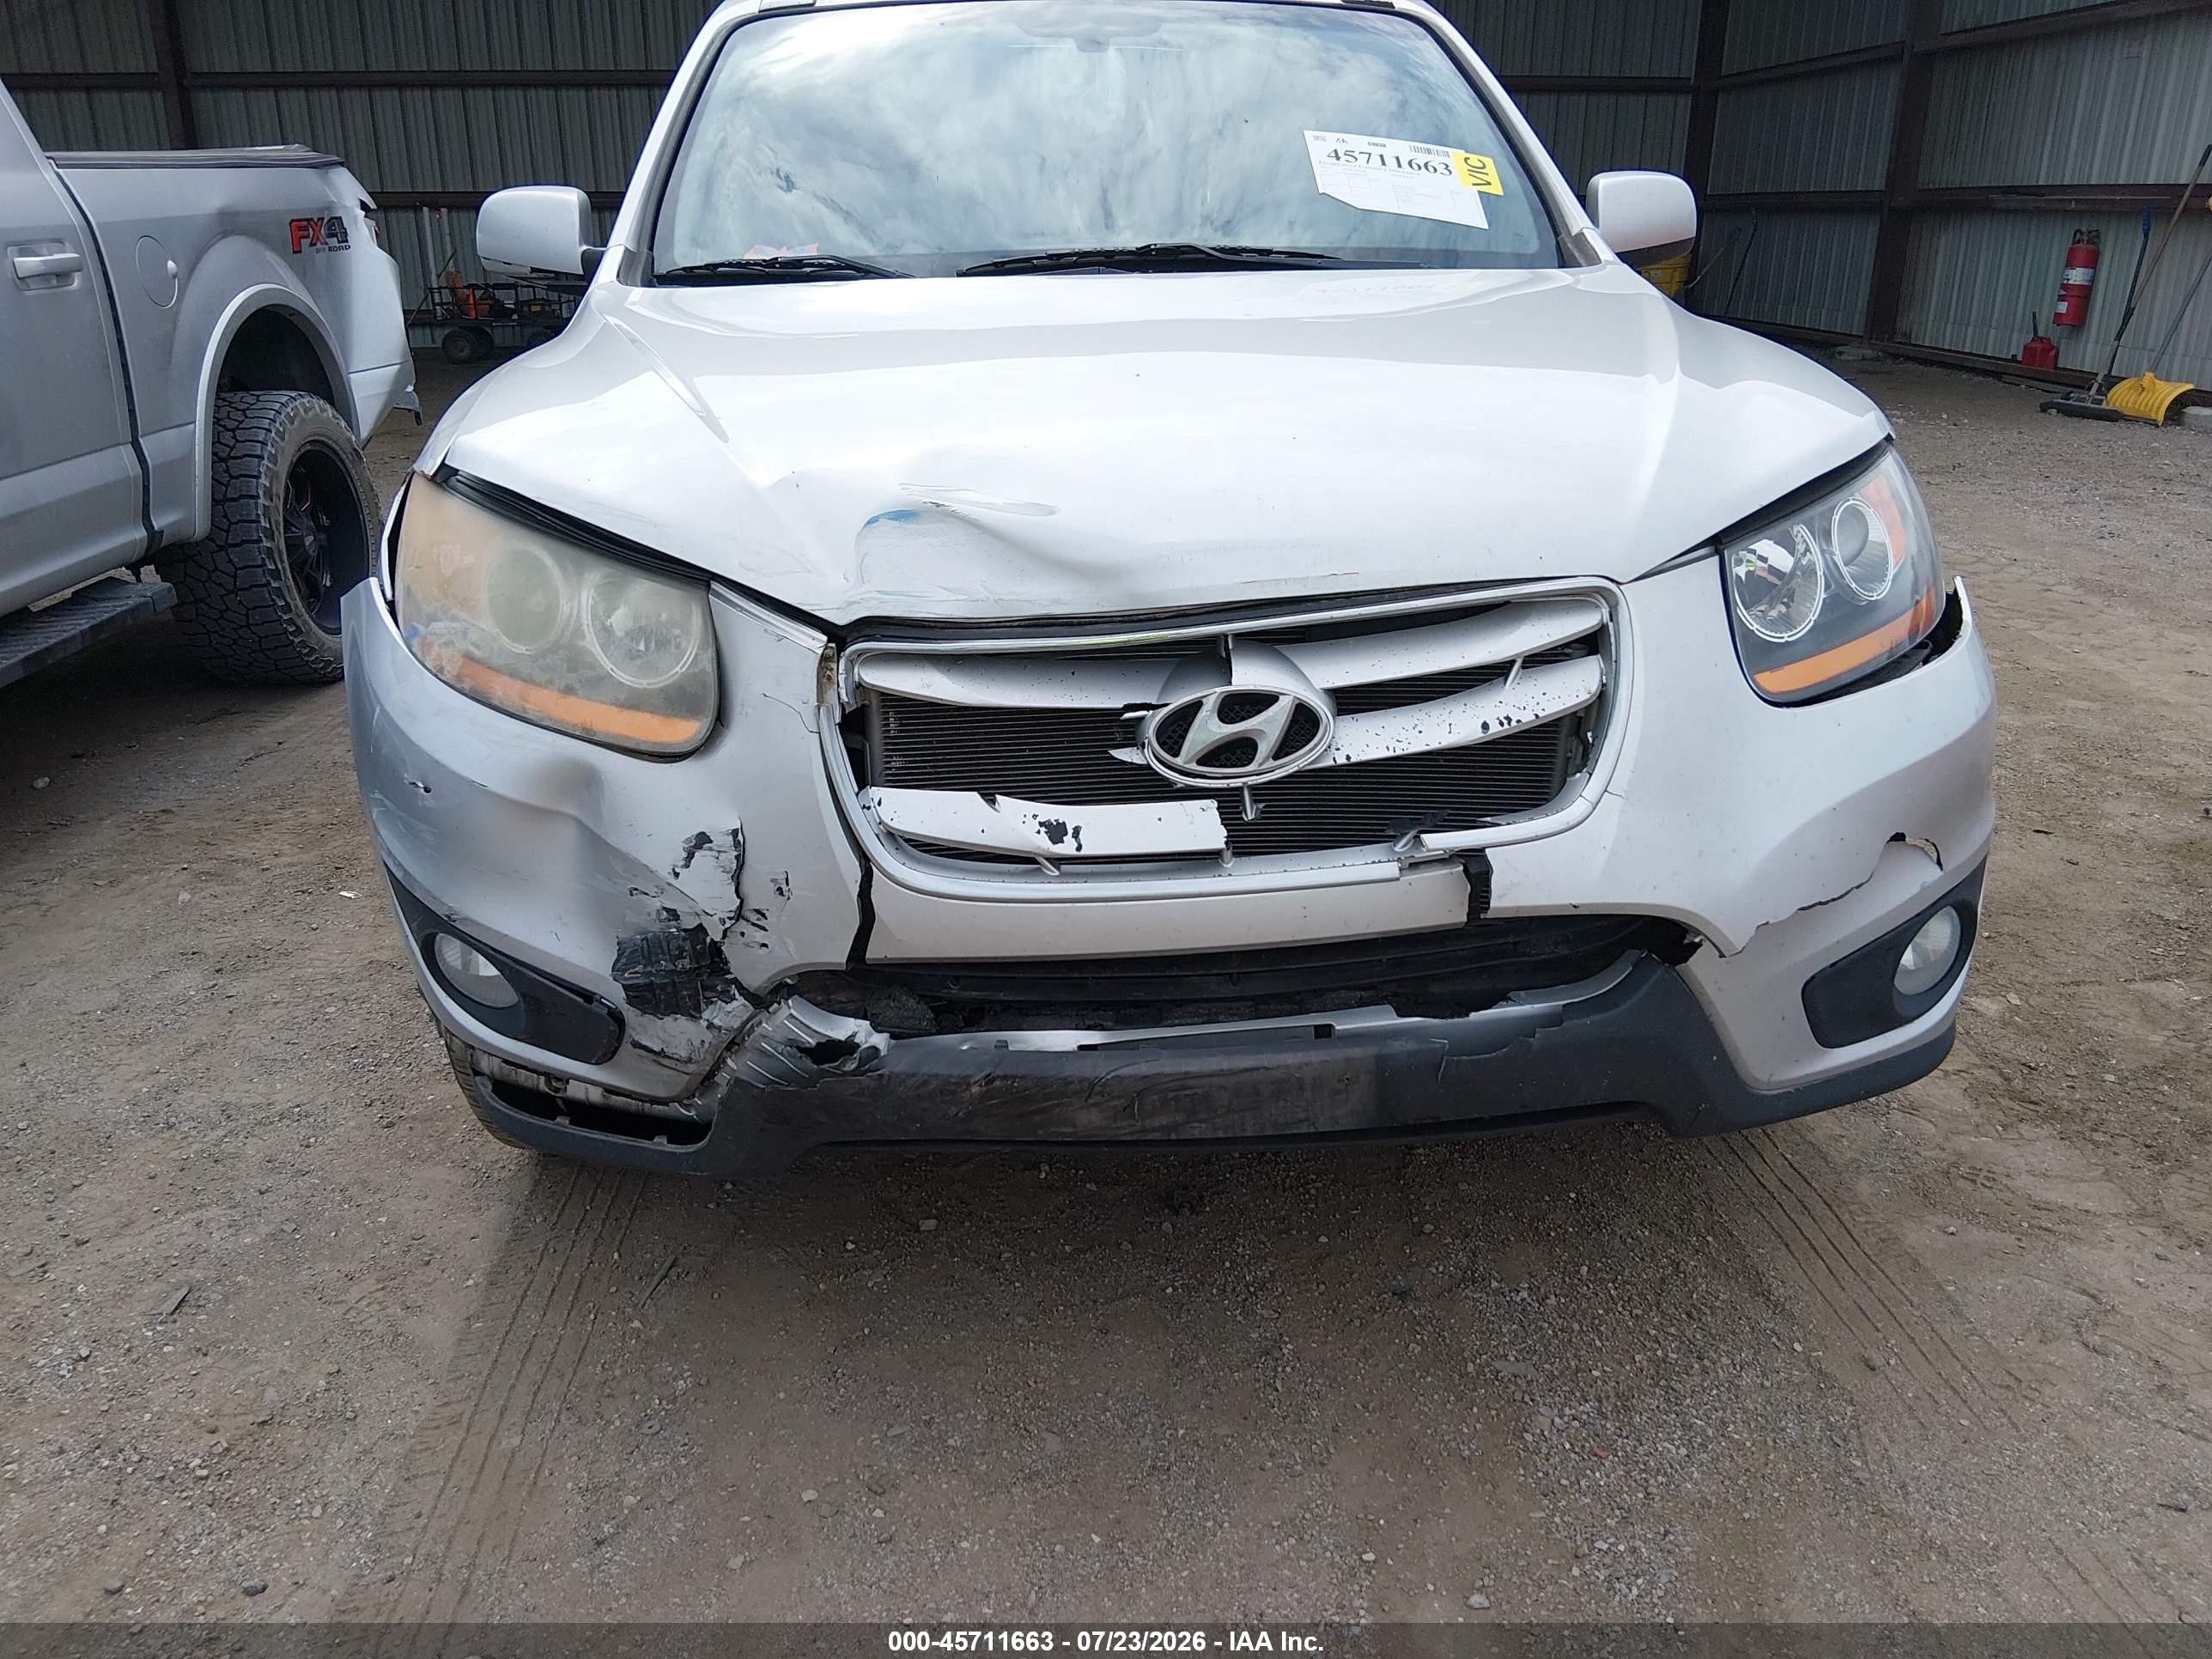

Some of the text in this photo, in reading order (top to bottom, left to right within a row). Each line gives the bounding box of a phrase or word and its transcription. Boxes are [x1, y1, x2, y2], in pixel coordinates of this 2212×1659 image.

[1327, 148, 1454, 177] 45711663
[1464, 156, 1492, 187] VIC
[289, 216, 349, 254] FX4
